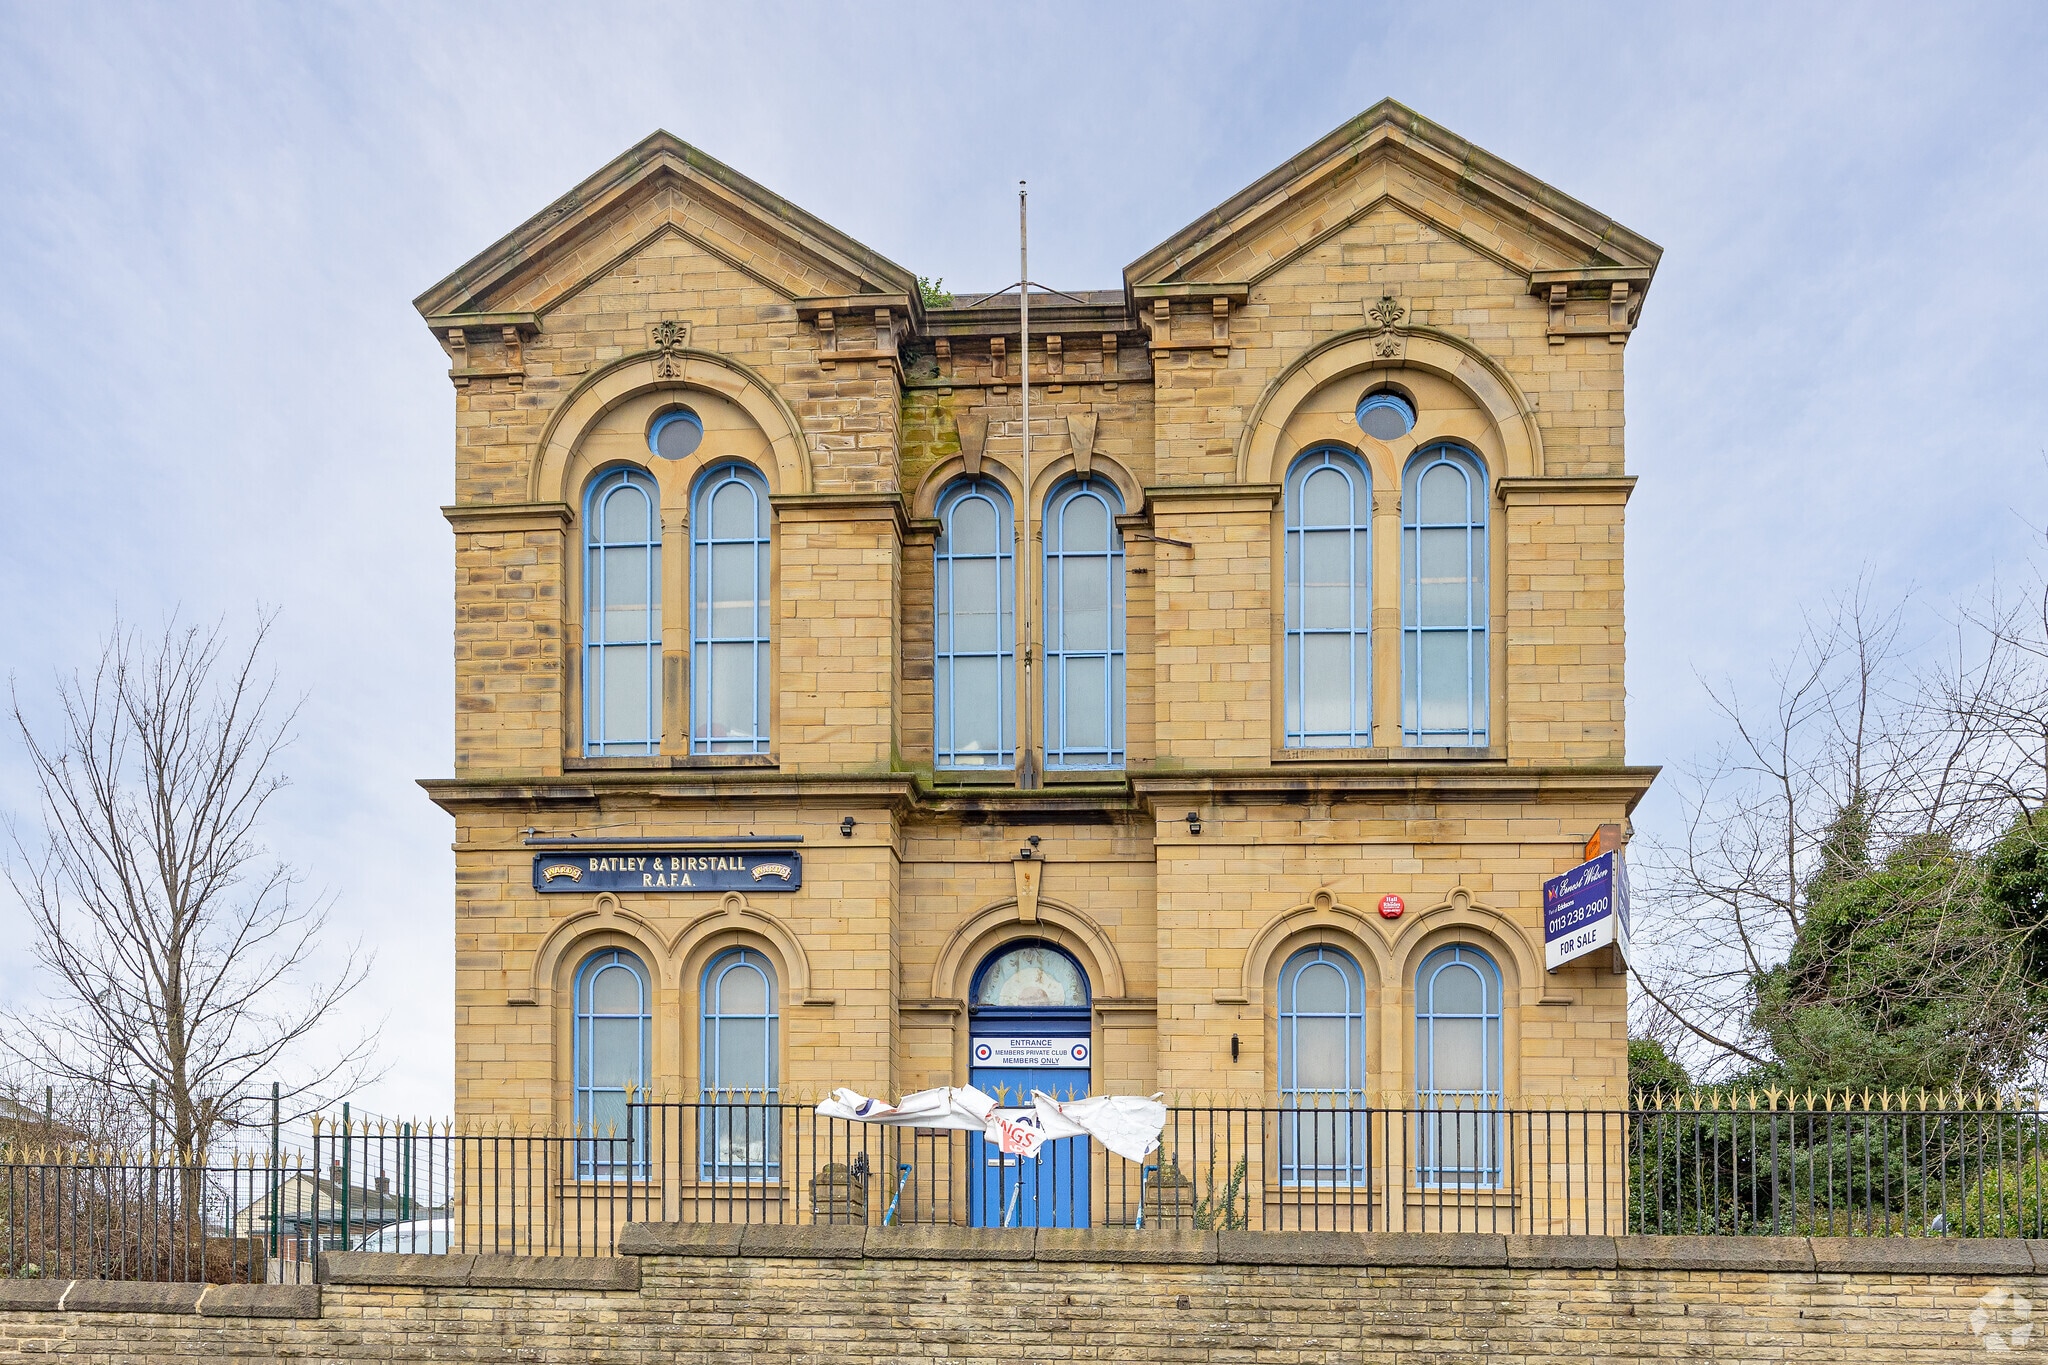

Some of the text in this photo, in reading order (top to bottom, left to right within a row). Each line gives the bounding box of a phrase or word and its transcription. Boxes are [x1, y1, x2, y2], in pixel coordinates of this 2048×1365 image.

[546, 865, 578, 877] WARD'S
[589, 857, 746, 872] BATLEY & BIRSTALL
[642, 873, 696, 887] R.A.F.A.
[1549, 896, 1608, 934] 0113 238 2900
[1560, 929, 1597, 956] FOR SALE
